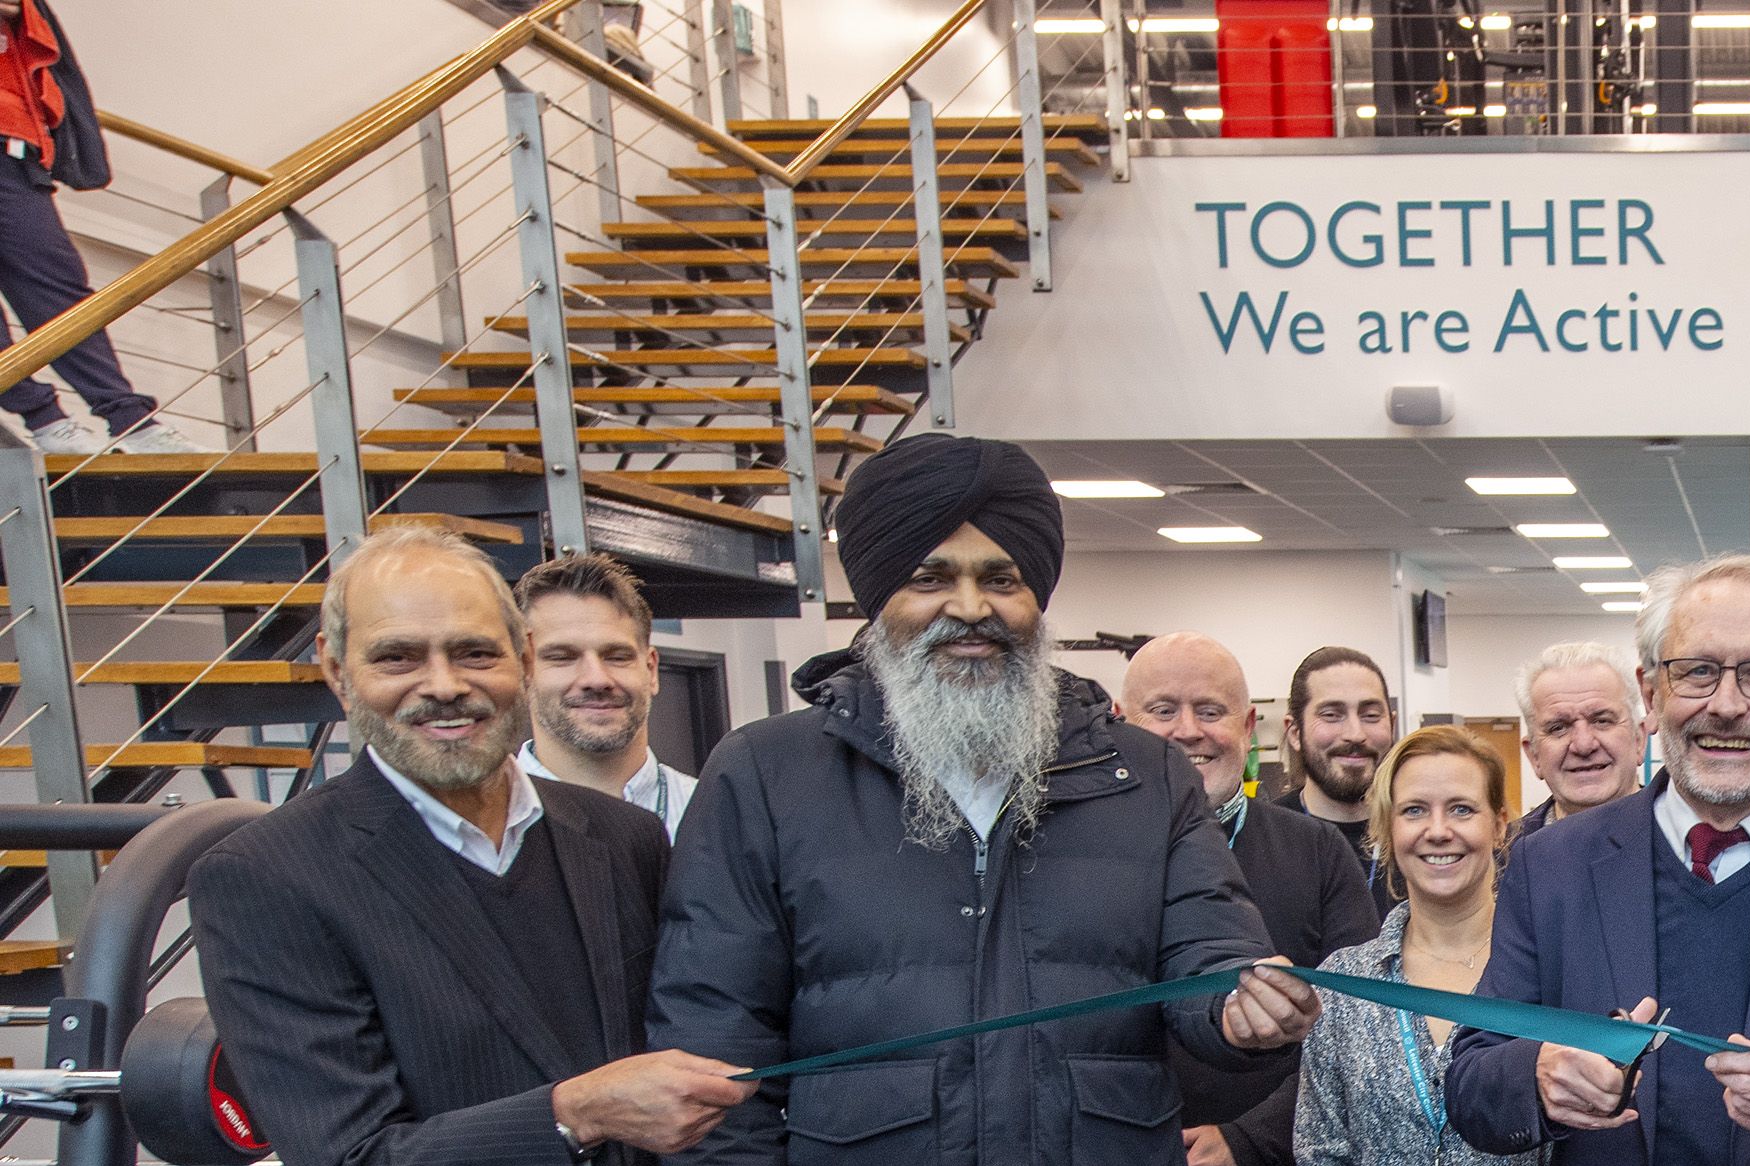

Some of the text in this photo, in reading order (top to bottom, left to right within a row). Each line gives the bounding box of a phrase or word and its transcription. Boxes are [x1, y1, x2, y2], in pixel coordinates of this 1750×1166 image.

[1195, 199, 1665, 268] TOGETHER
[1199, 290, 1325, 354] We
[1358, 309, 1470, 354] are
[1493, 288, 1724, 352] Active
[1408, 1048, 1422, 1081] Leicester
[1418, 1081, 1426, 1098] City
